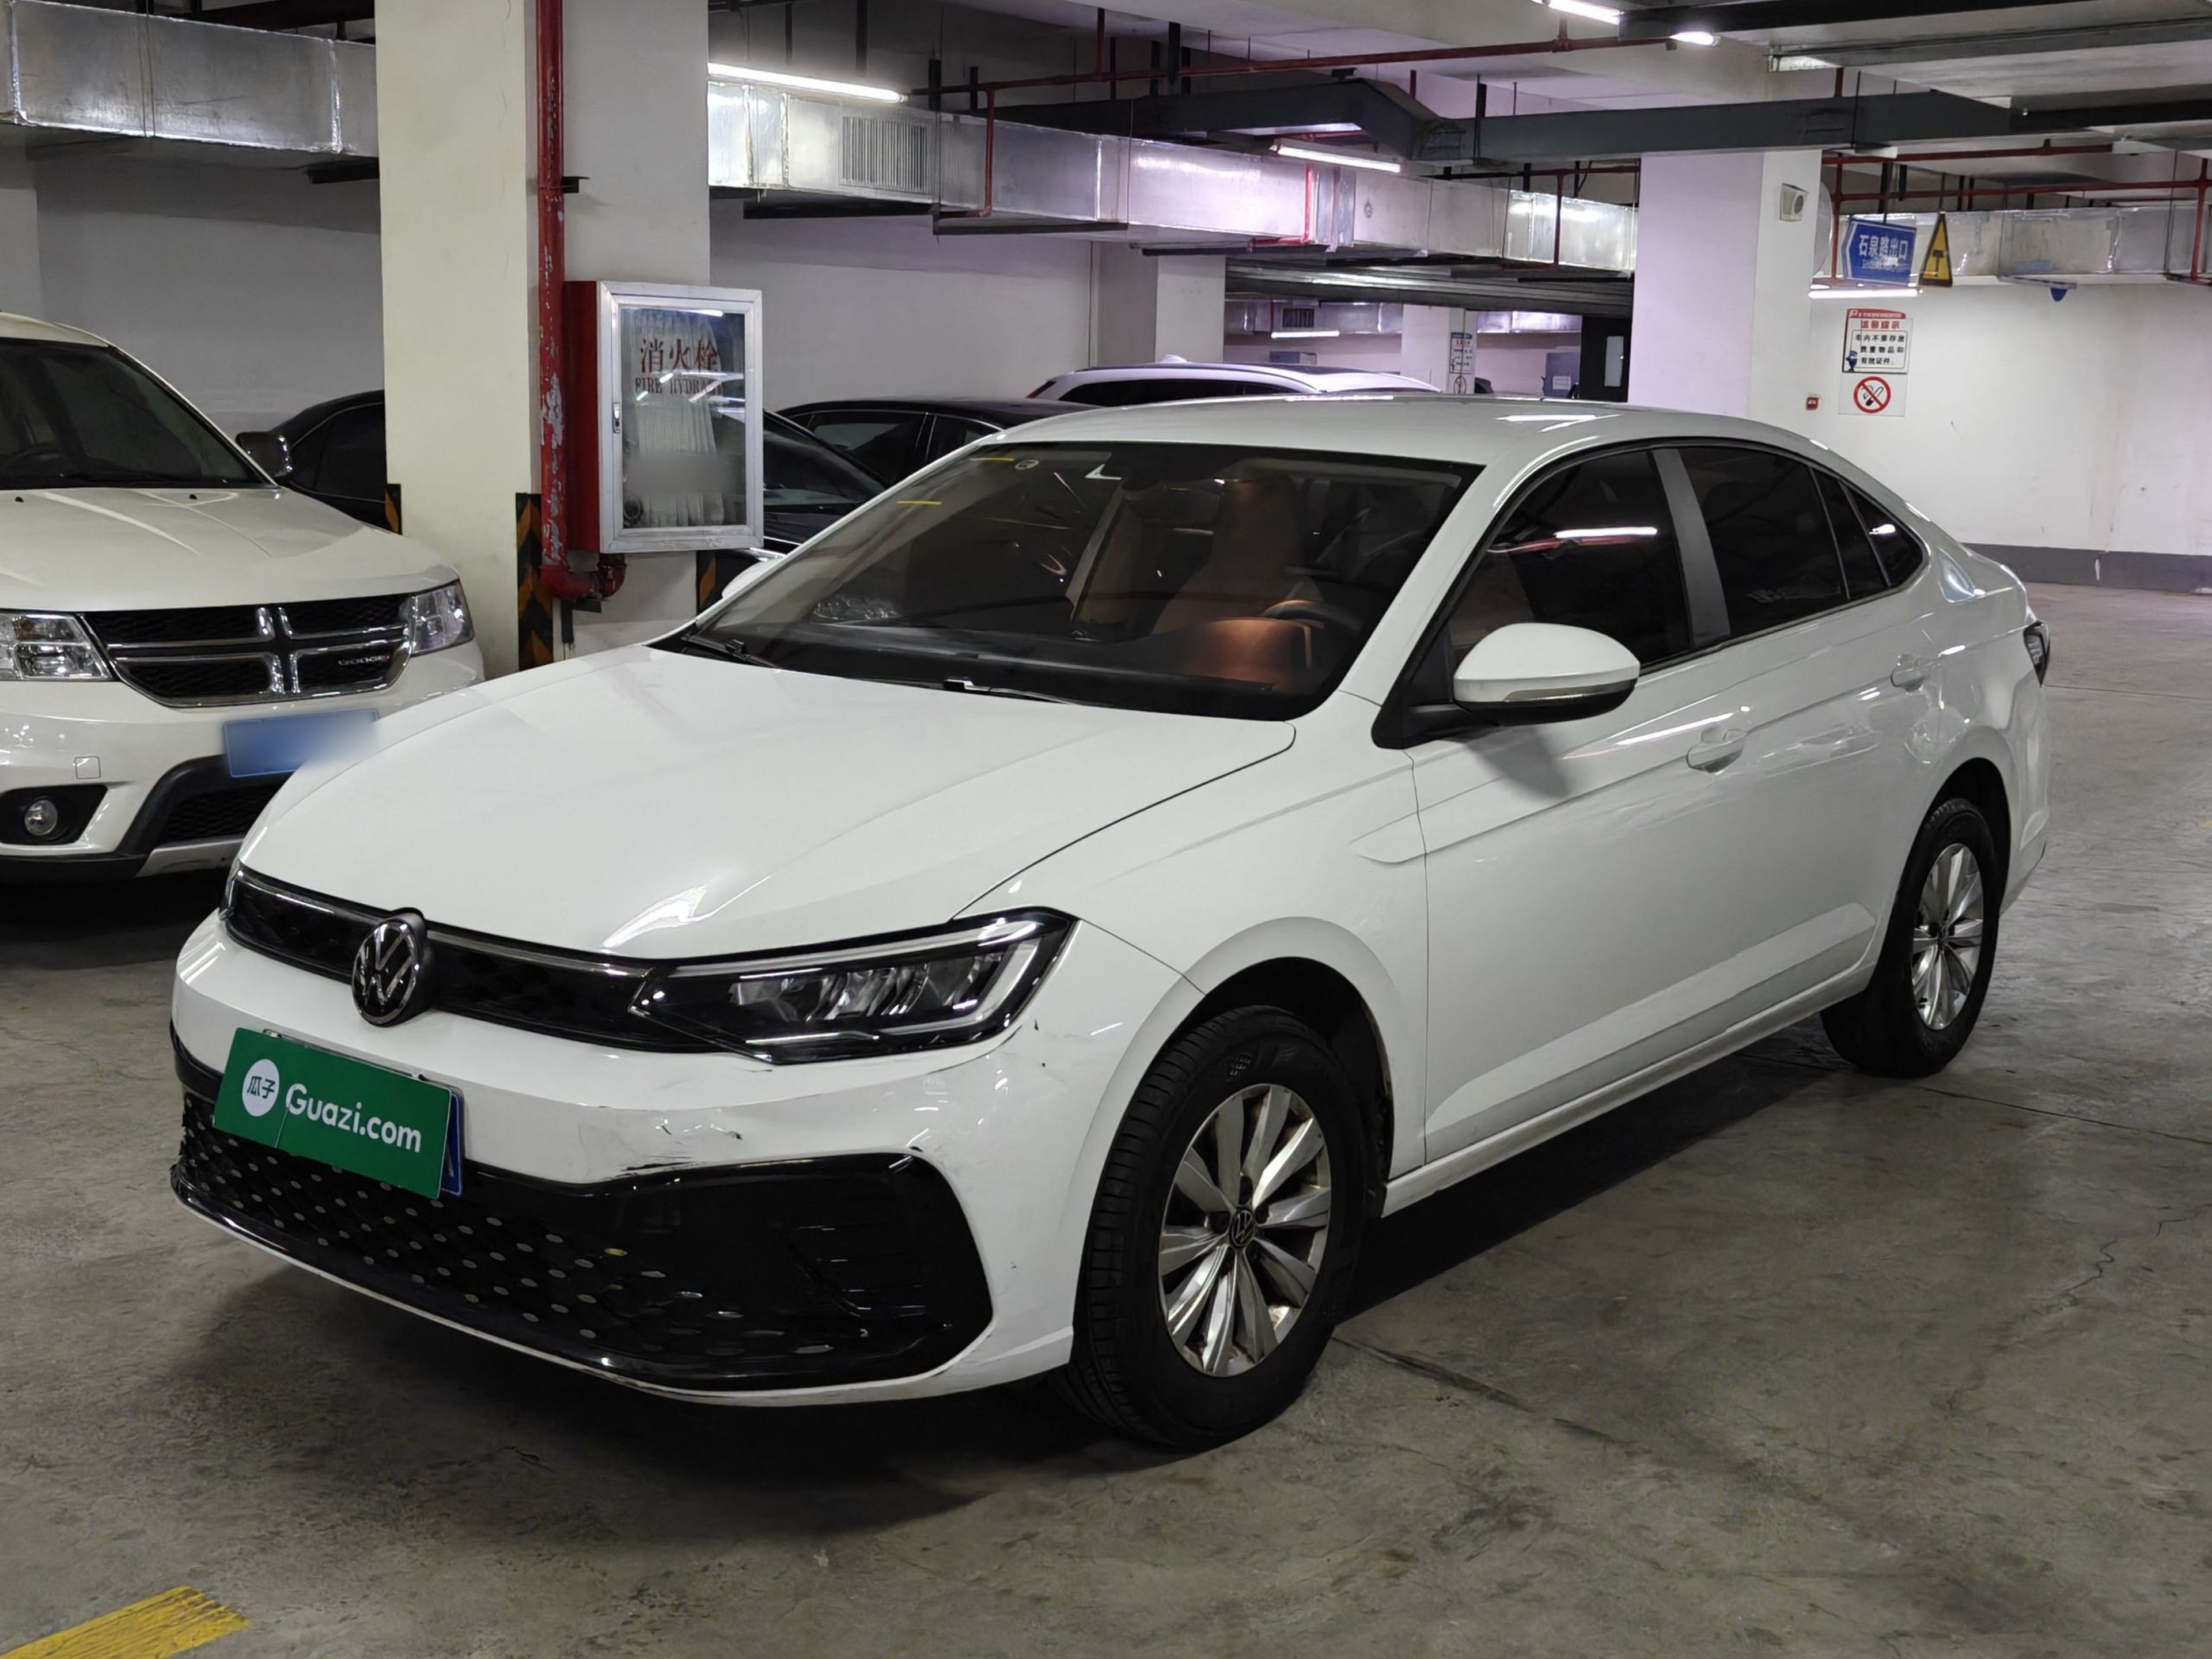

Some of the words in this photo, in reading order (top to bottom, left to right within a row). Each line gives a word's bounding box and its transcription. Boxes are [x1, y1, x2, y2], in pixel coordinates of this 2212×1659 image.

[1859, 234, 1908, 261] 石泉路出口
[641, 338, 718, 374] 消火栓
[635, 377, 662, 394] FIRE
[247, 1075, 276, 1099] 瓜子
[285, 1083, 422, 1153] Guazi.com
